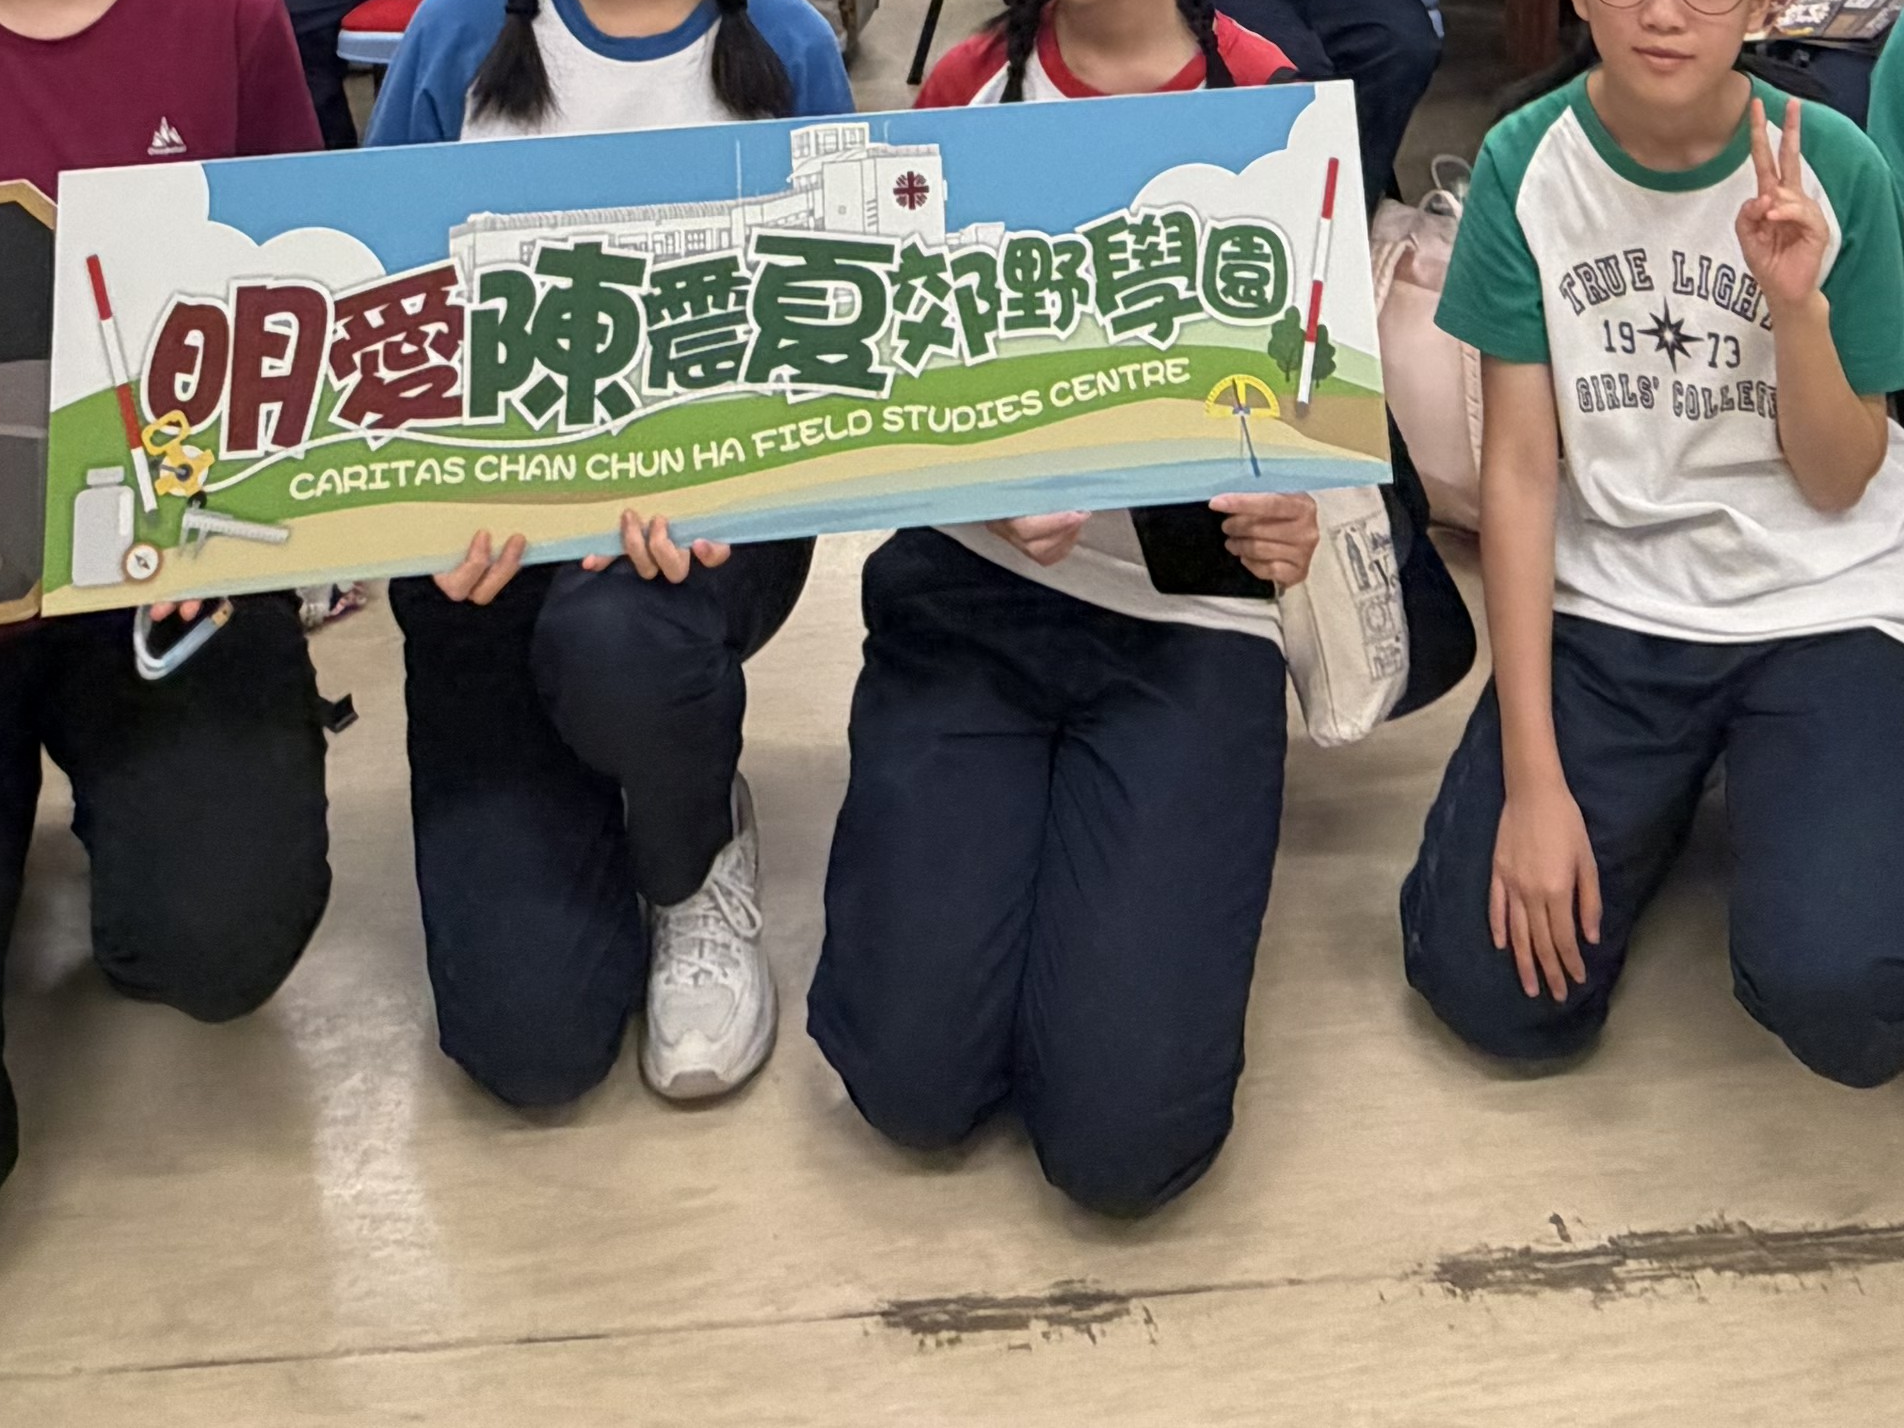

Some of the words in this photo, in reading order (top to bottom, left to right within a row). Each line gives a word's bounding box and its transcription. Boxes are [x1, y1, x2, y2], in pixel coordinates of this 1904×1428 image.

[1558, 247, 1655, 316] TRUE
[143, 204, 1293, 456] 明愛陳震夏郊野學園
[1603, 319, 1637, 355] 19
[1707, 331, 1741, 369] 73
[288, 455, 466, 501] CARITAS
[474, 454, 577, 482] CHAN
[584, 445, 686, 481] CHUN
[694, 437, 747, 470] HA
[752, 410, 873, 454] FIELD
[881, 390, 1044, 434] STUDIES
[1050, 357, 1191, 408] CENTRE
[1575, 372, 1660, 414] GIRLS'
[1672, 379, 1778, 421] COLLEG
